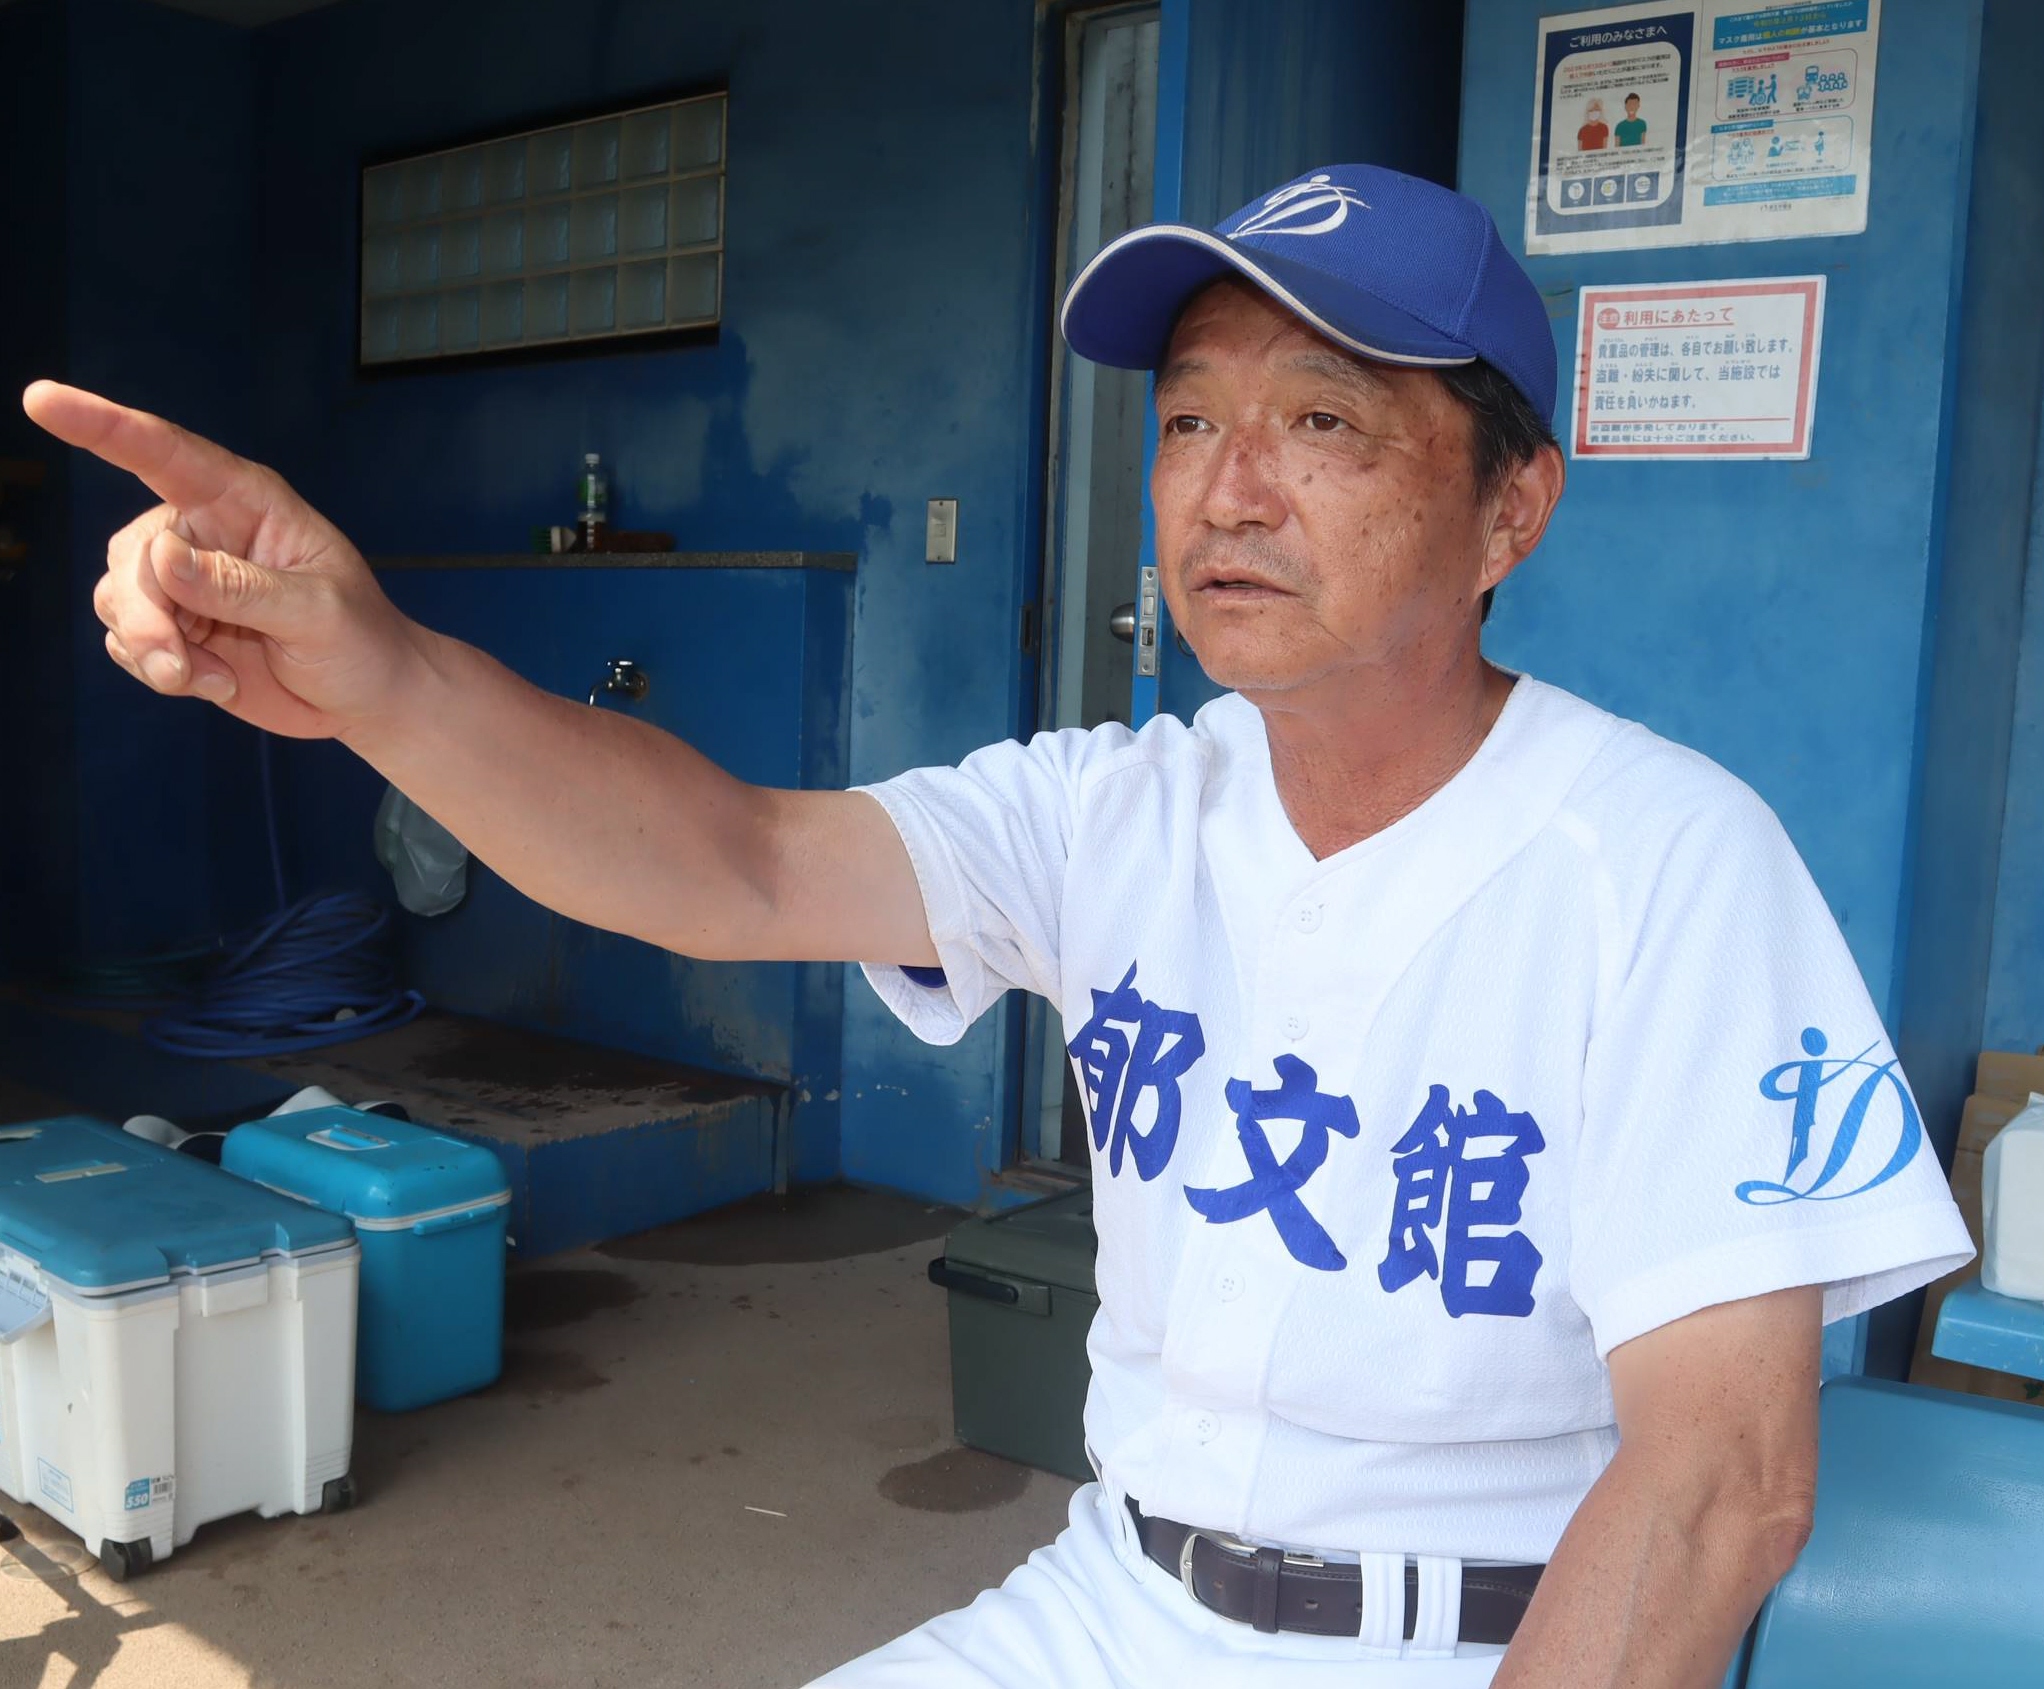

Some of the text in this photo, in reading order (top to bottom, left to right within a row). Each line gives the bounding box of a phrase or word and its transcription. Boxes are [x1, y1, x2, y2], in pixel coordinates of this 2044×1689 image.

[1568, 26, 1668, 48] ご利用のみなさまへ
[1595, 364, 1781, 383] 盗難・紛失に関して、当施設では
[1594, 395, 1696, 411] 責任を負いかねます。
[1068, 960, 1545, 1318] 郁文館
